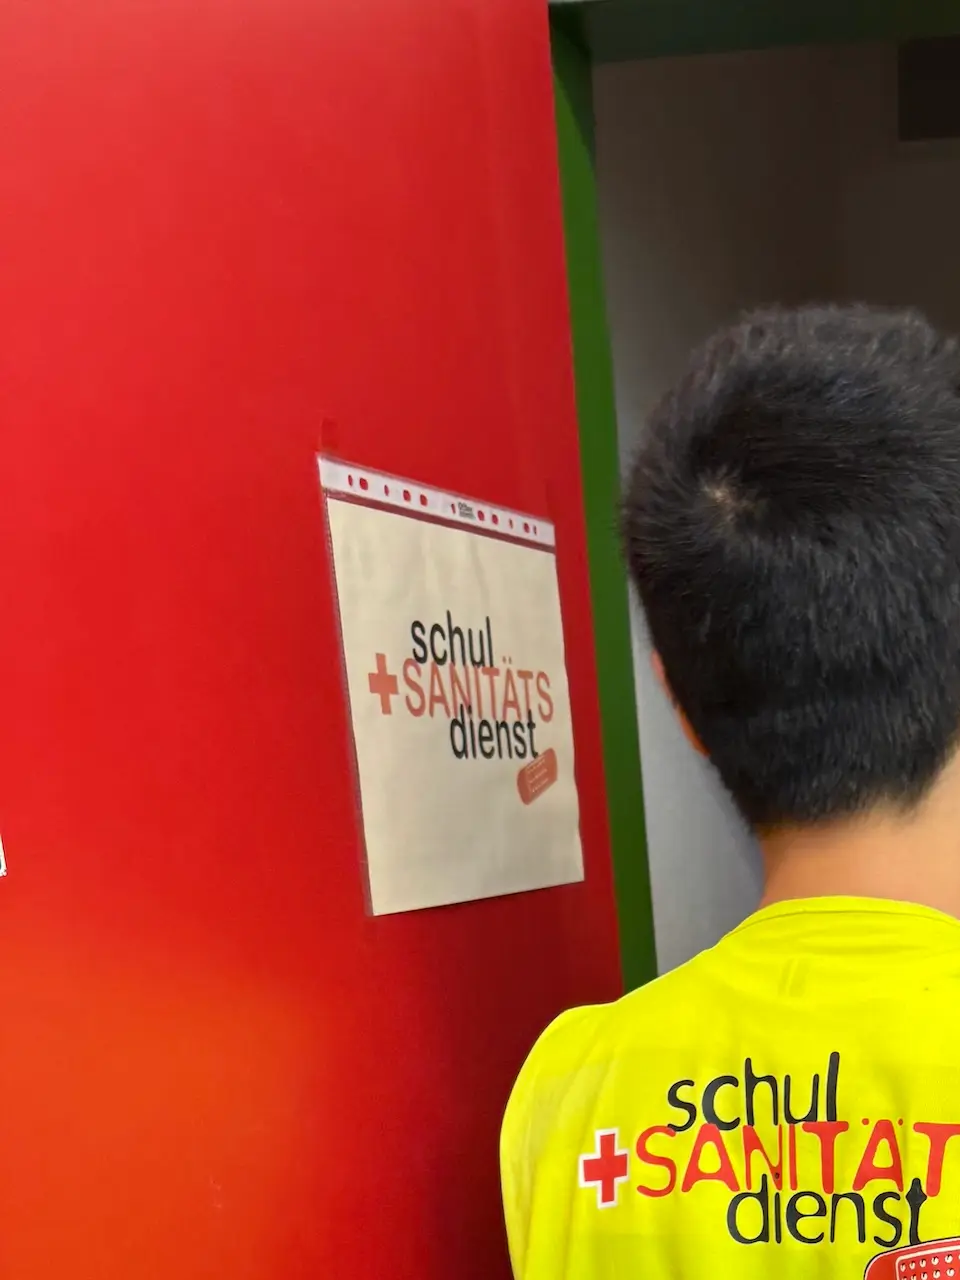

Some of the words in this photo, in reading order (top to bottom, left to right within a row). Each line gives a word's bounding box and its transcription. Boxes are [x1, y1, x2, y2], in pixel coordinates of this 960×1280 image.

[411, 610, 494, 667] schul
[402, 658, 554, 721] SANITÄTS
[450, 704, 539, 759] dienst
[667, 1051, 840, 1132] schul
[727, 1173, 928, 1247] dienst
